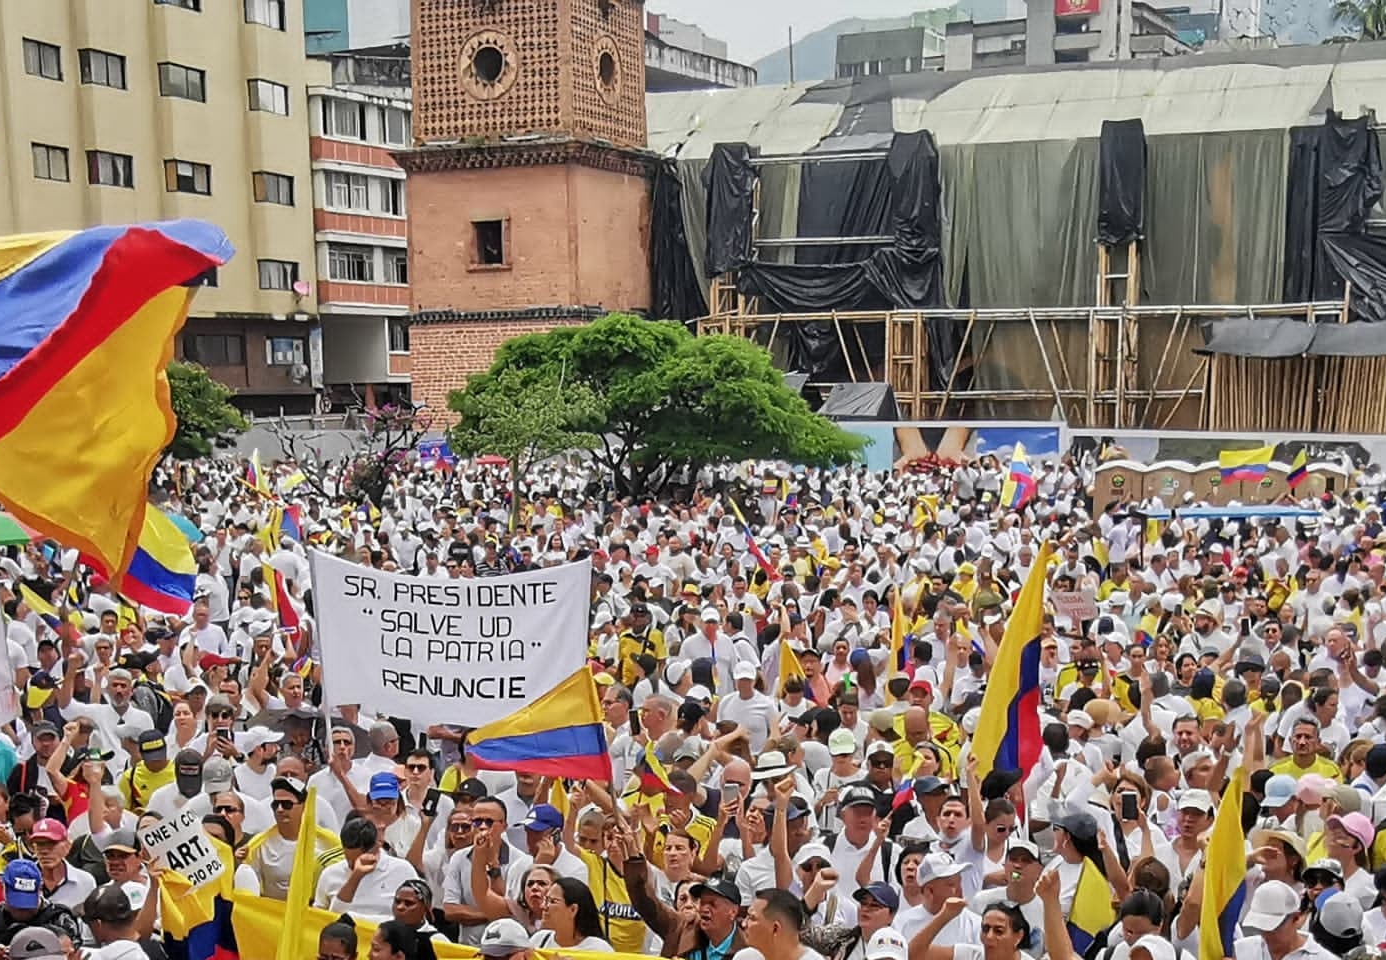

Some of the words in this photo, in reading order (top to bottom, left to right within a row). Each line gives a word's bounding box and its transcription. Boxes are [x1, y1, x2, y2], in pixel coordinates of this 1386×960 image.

[344, 575, 381, 600] SR.
[394, 582, 558, 608] PRESIDENTE
[479, 616, 512, 638] UD
[381, 634, 412, 660] LA
[382, 668, 526, 699] RENUNCIE
[144, 825, 171, 847] CNE
[169, 820, 180, 833] Y
[166, 835, 210, 871] ART.
